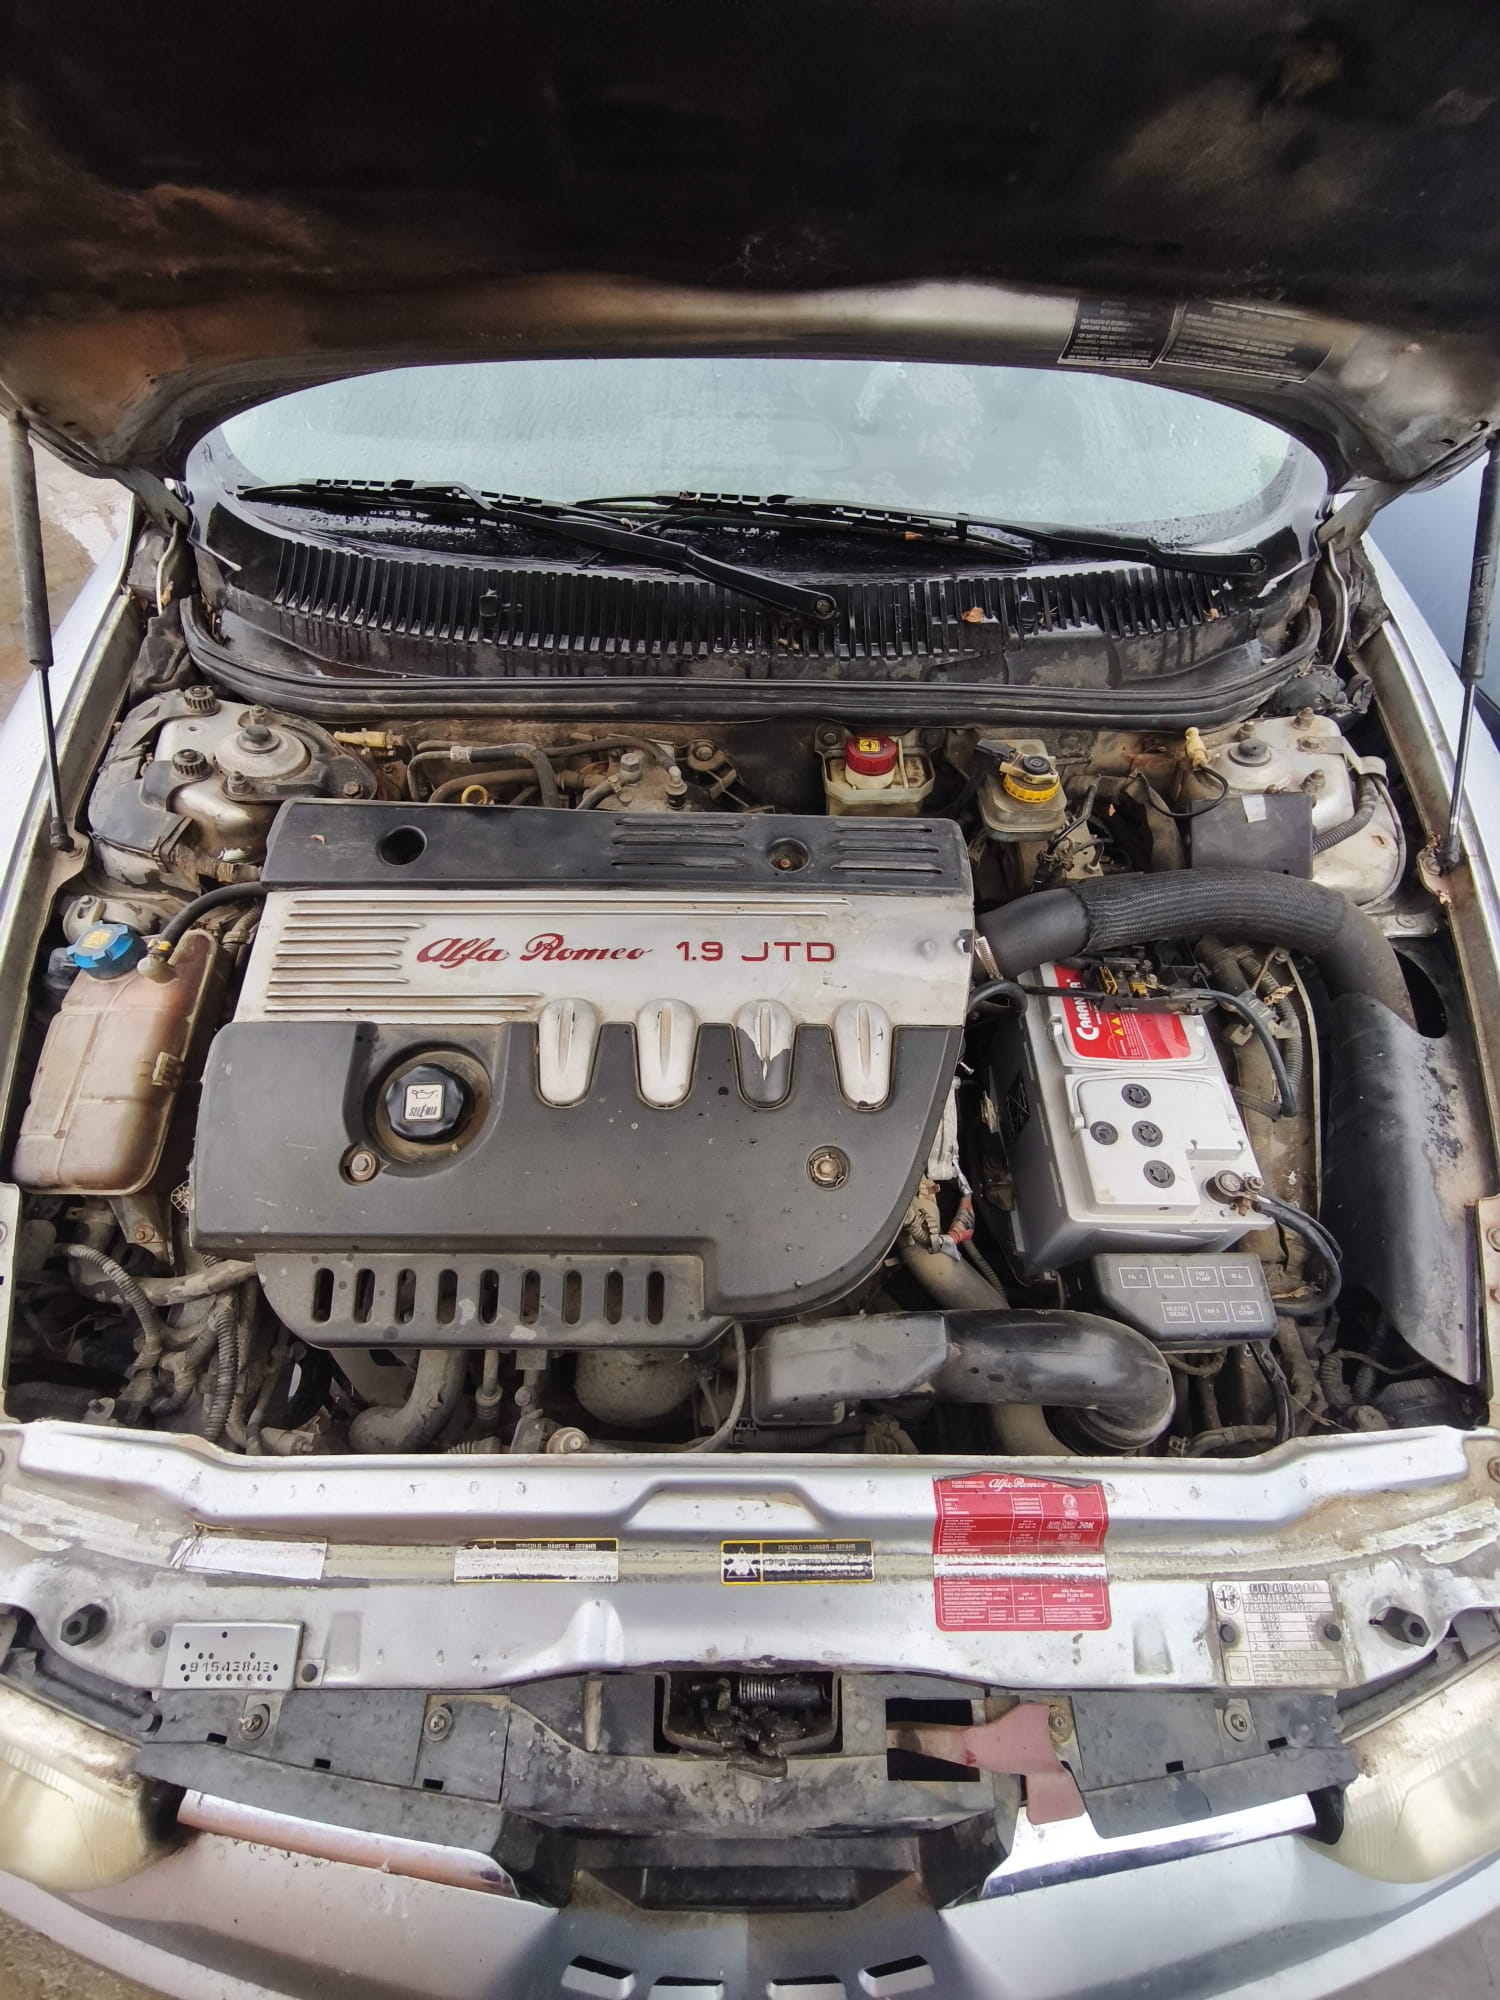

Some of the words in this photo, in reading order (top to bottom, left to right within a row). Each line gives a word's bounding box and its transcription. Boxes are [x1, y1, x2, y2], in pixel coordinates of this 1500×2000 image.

[416, 937, 510, 968] Alfa
[519, 932, 654, 962] Romeo
[676, 941, 723, 961] 1.9
[741, 941, 836, 962] JTD
[1069, 981, 1100, 1041] CARANA
[989, 1478, 1012, 1491] Alfa
[1013, 1477, 1048, 1489] Romeo
[1273, 1583, 1293, 1592] AUTO
